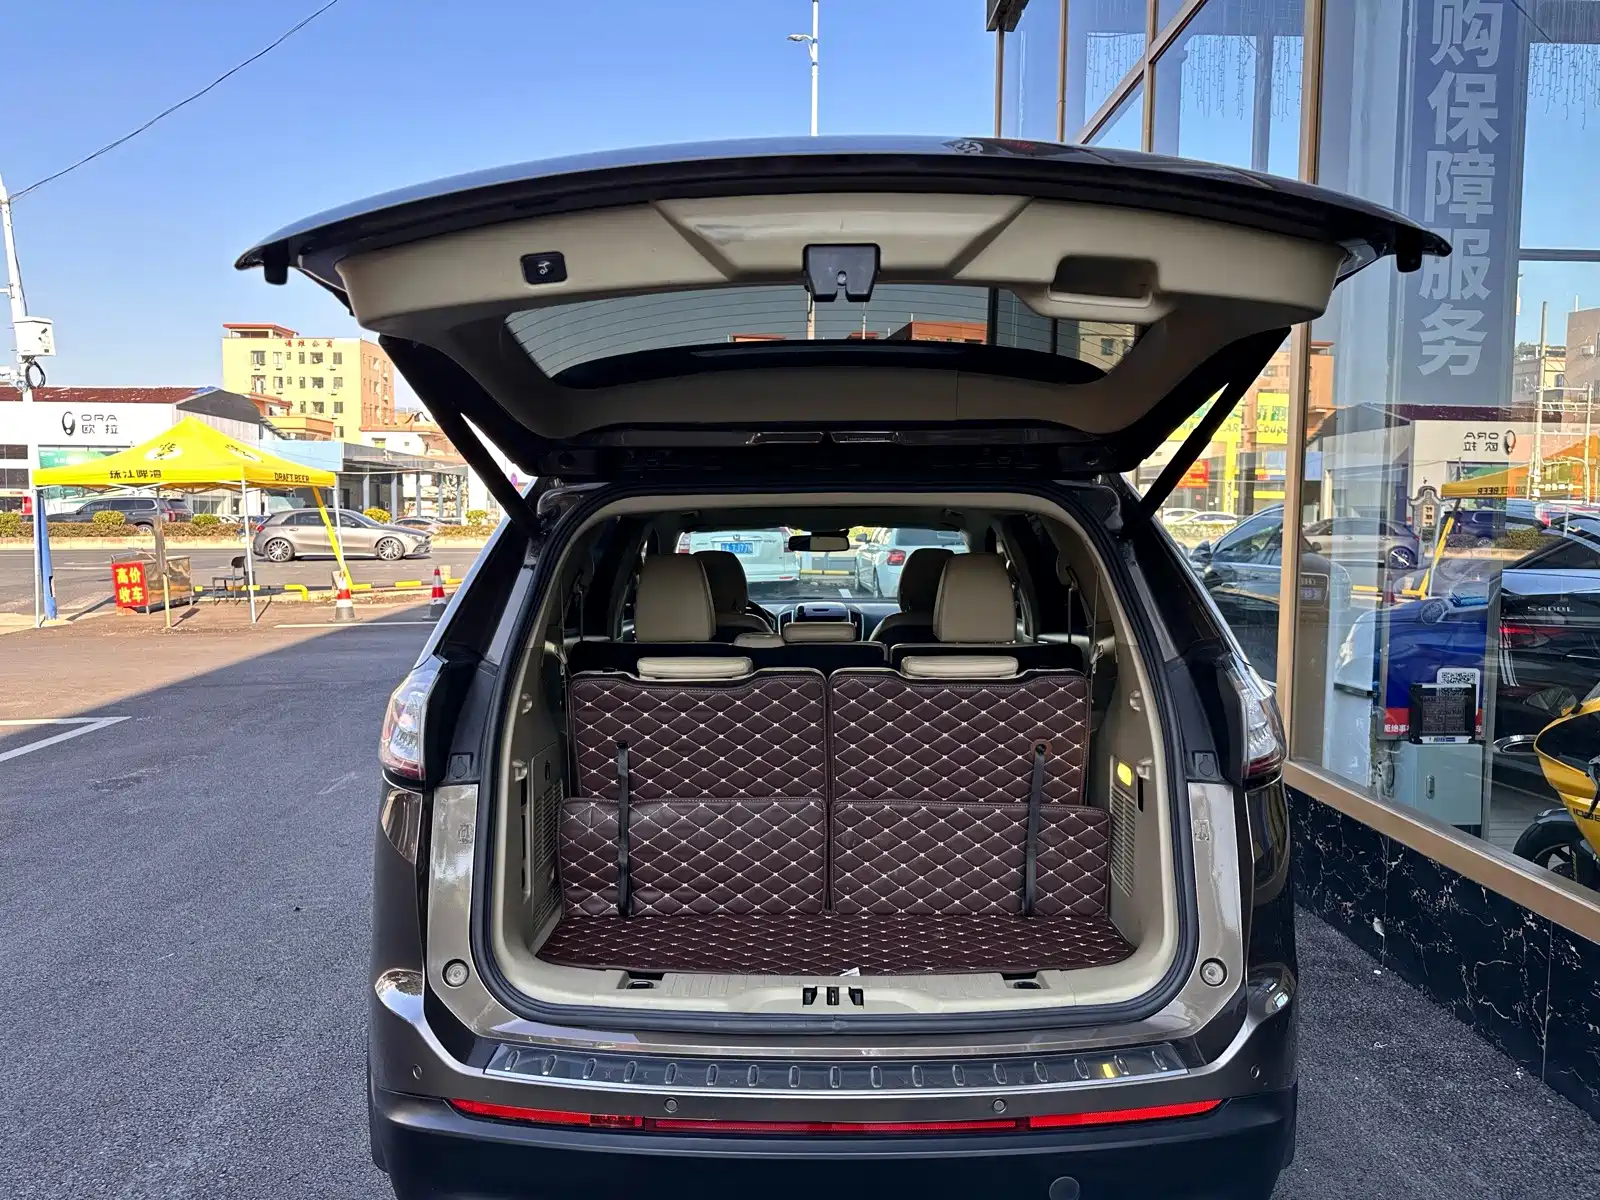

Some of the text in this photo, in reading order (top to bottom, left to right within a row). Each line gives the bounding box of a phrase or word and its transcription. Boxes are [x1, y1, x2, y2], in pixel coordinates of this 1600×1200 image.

[81, 424, 118, 434] 欧拉
[109, 469, 161, 479] 珠江啤酒
[274, 472, 310, 483] DRAFT BEER
[115, 567, 141, 584] 高价
[118, 586, 144, 603] 收车
